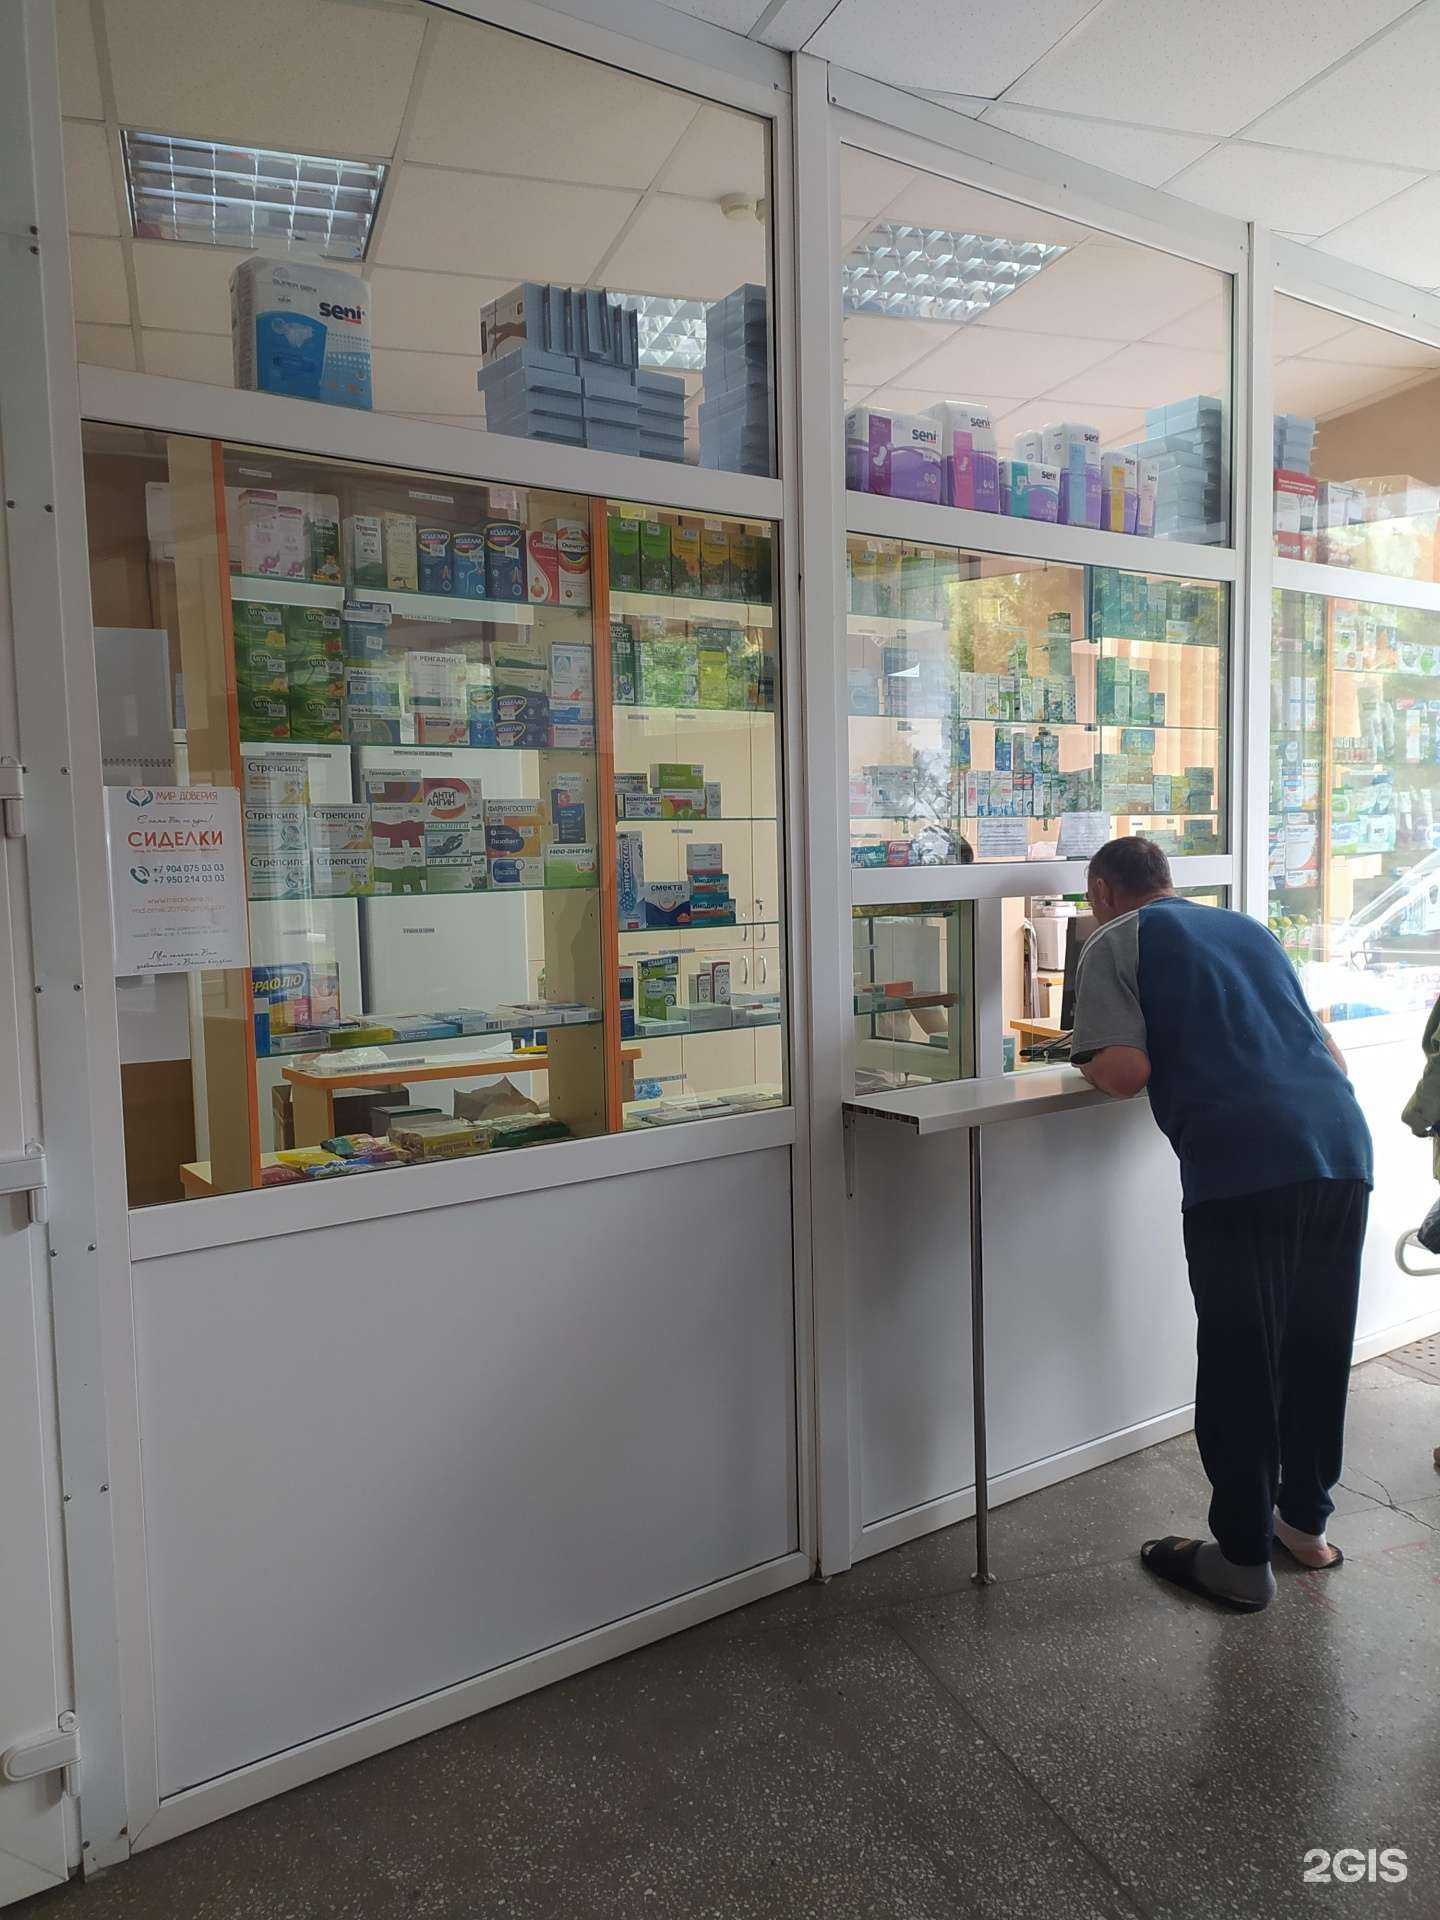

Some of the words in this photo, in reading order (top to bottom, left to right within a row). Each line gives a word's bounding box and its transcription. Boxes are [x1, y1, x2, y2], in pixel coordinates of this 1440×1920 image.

[319, 301, 362, 321] seni
[970, 417, 991, 428] seni
[911, 428, 937, 442] seni
[155, 791, 176, 801] МИР
[179, 791, 218, 801] ДОВЕРИЯ
[432, 791, 456, 800] АНТИ
[427, 799, 456, 807] АНГИН
[245, 808, 299, 821] Стрепсилс
[313, 809, 366, 821] Стрепсилс
[127, 830, 223, 849] СИДЕЛКИ
[165, 864, 182, 873] 904
[183, 863, 200, 872] 075
[201, 864, 212, 872] 03
[214, 863, 225, 872] 03
[317, 856, 368, 868] Стрепсилс
[153, 875, 164, 885] +7
[166, 875, 183, 884] 950
[184, 875, 200, 883] 214
[214, 873, 225, 882] 03
[252, 974, 302, 993] РАФЛЮ
